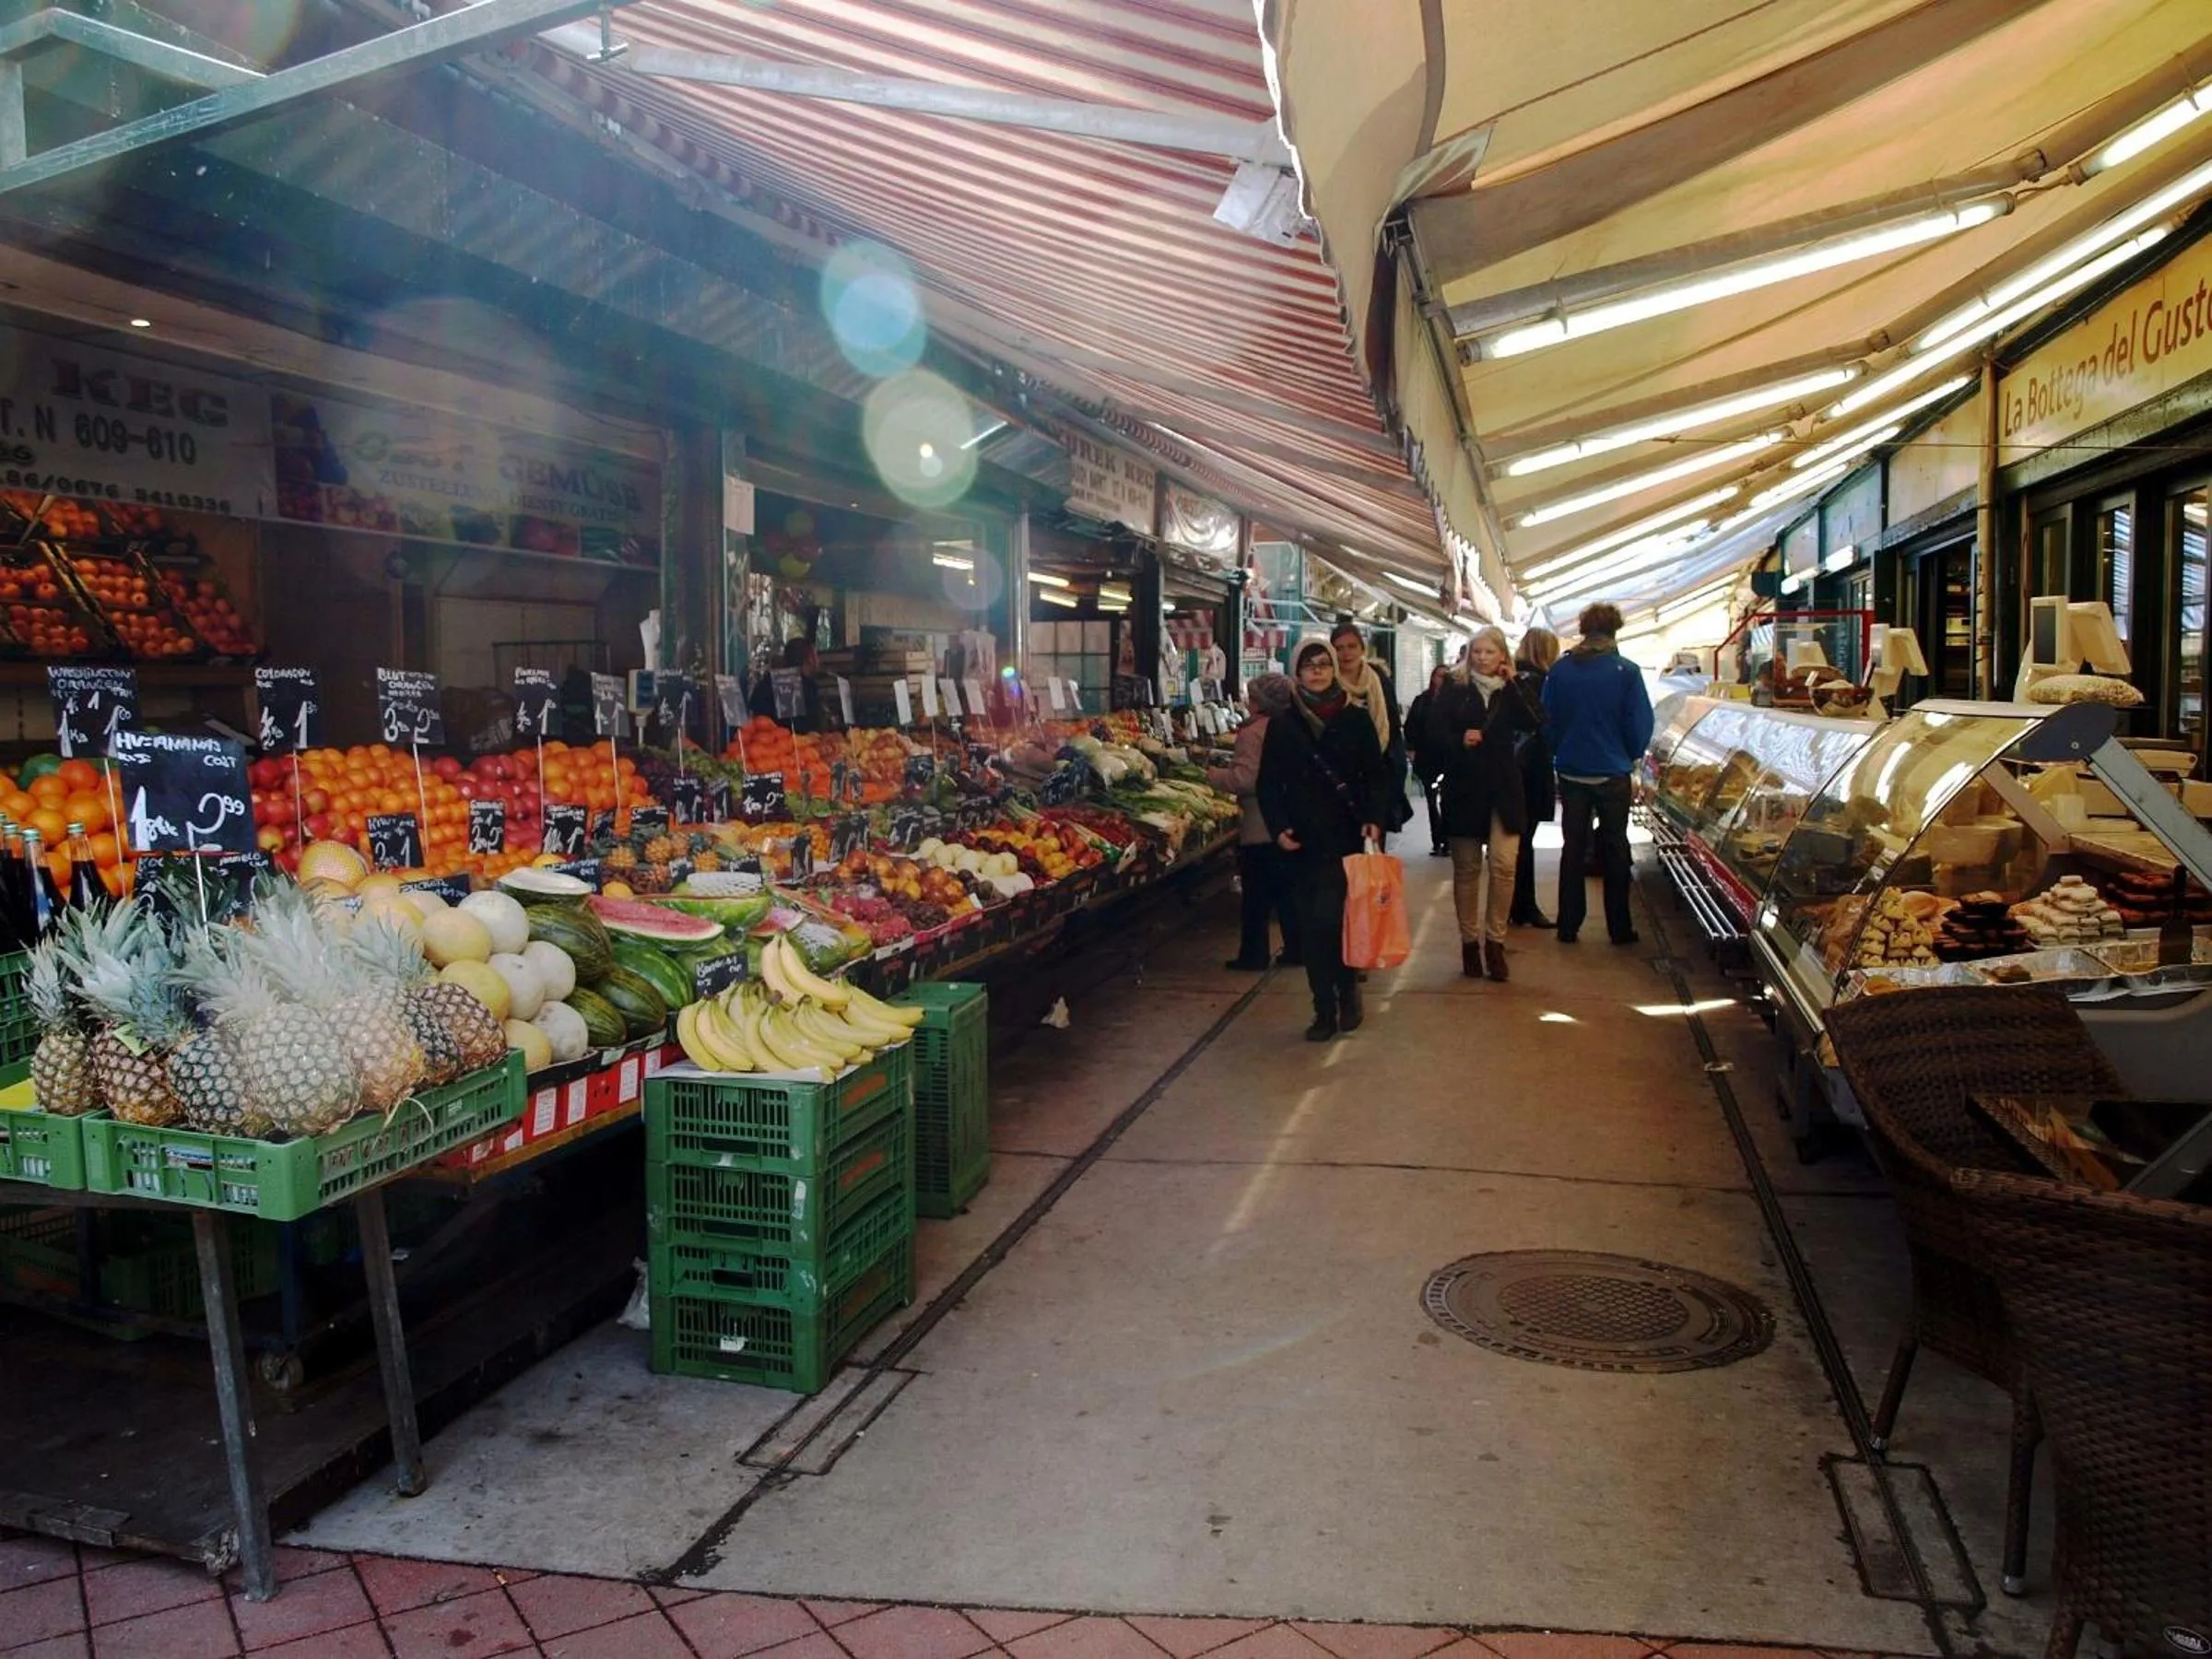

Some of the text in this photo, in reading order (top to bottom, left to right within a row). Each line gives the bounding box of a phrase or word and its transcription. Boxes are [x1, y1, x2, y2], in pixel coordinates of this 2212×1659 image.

[2004, 277, 2212, 438] La Bottega del Gust
